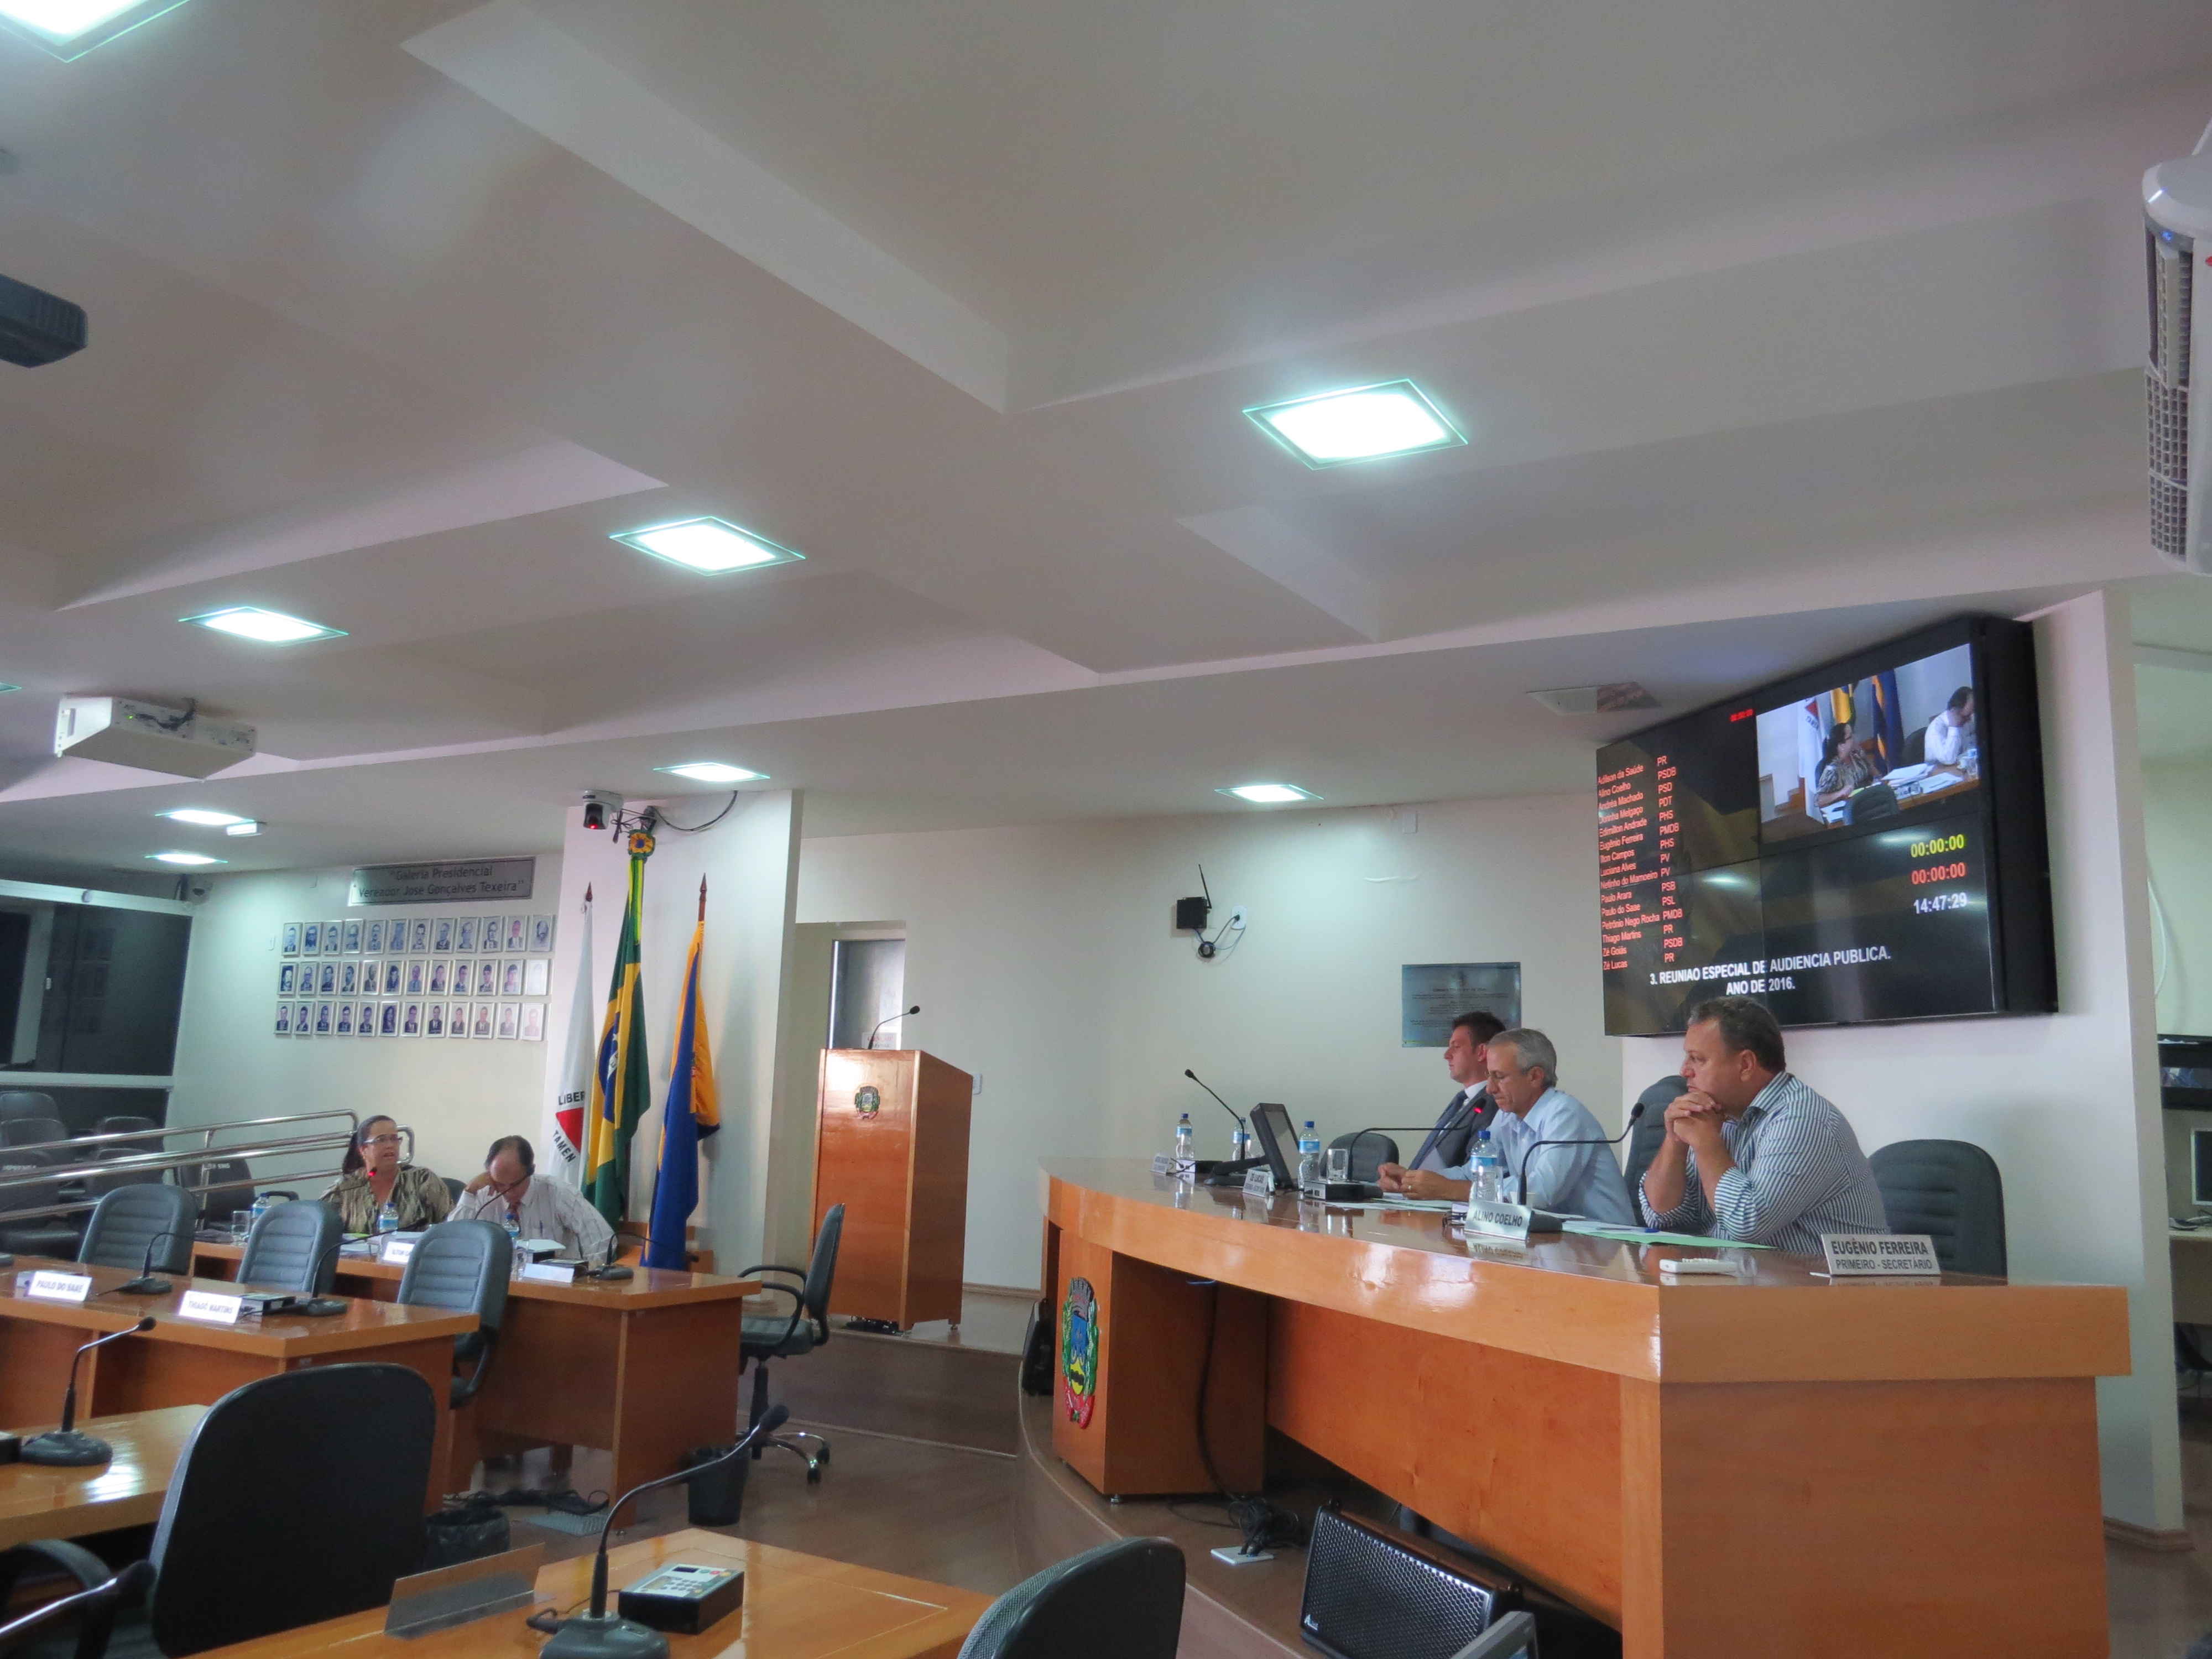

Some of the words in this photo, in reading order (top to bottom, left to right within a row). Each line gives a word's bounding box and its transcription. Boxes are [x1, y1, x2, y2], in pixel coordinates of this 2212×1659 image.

[1657, 756, 1667, 766] PR
[1611, 782, 1631, 794] Coelho
[1658, 767, 1676, 780] PSDB
[1618, 791, 1644, 806] Machado
[1658, 782, 1672, 794] PSD
[1659, 796, 1672, 807] PDT
[1624, 818, 1647, 831] Andrade
[1659, 810, 1673, 821] PHS
[1622, 832, 1644, 844] Ferreira
[1660, 823, 1679, 836] PMDB
[1611, 849, 1635, 860] Campos
[1660, 838, 1674, 849] PHS
[1911, 834, 1964, 858] 00:00:00
[432, 865, 493, 879] Presidencial
[1621, 863, 1636, 872] Alves
[1661, 853, 1670, 863] PV
[1630, 870, 1658, 883] Mamoeiro
[1661, 867, 1671, 877] PV
[1911, 862, 1965, 885] 00:00:00
[359, 886, 399, 898] Vereador
[427, 881, 477, 896] Gonçalves
[1601, 893, 1615, 903] Paulo
[1616, 891, 1631, 900] Arara
[1662, 881, 1676, 892] PSB
[1601, 907, 1616, 916] Paulo
[1618, 905, 1624, 914] do
[1626, 904, 1640, 912] Saae
[1662, 896, 1676, 906] PSL
[1913, 892, 1968, 914] 14:47:29
[1625, 917, 1640, 927] Nego
[1641, 913, 1660, 924] Rocha
[1663, 909, 1683, 920] PMDB
[1603, 934, 1620, 943] Thiago
[1621, 930, 1642, 941] Martins
[1663, 924, 1673, 934] PR
[1664, 937, 1683, 948] PSDB
[1611, 961, 1627, 969] Lucas
[1665, 952, 1674, 963] PR
[1650, 973, 1658, 985] 3.
[1660, 968, 1700, 984] REUNIAO
[1703, 962, 1751, 980] ESPECIAL
[1752, 961, 1765, 974] DE
[1769, 953, 1831, 973] AUDIENCIA
[1833, 946, 1891, 966] PUBLICA.
[1725, 980, 1749, 995] ANO
[1750, 979, 1765, 994] DE
[1768, 977, 1796, 992] 2016.
[552, 1129, 576, 1163] TAMEN
[1473, 1210, 1493, 1223] ALINO
[1495, 1213, 1522, 1227] COELHO
[1830, 1238, 1877, 1255] EUGÊNIO
[1879, 1241, 1928, 1255] FERREIRA
[1835, 1259, 1876, 1270] PRIMEIRO
[1882, 1256, 1933, 1269] SECRETÁRIO
